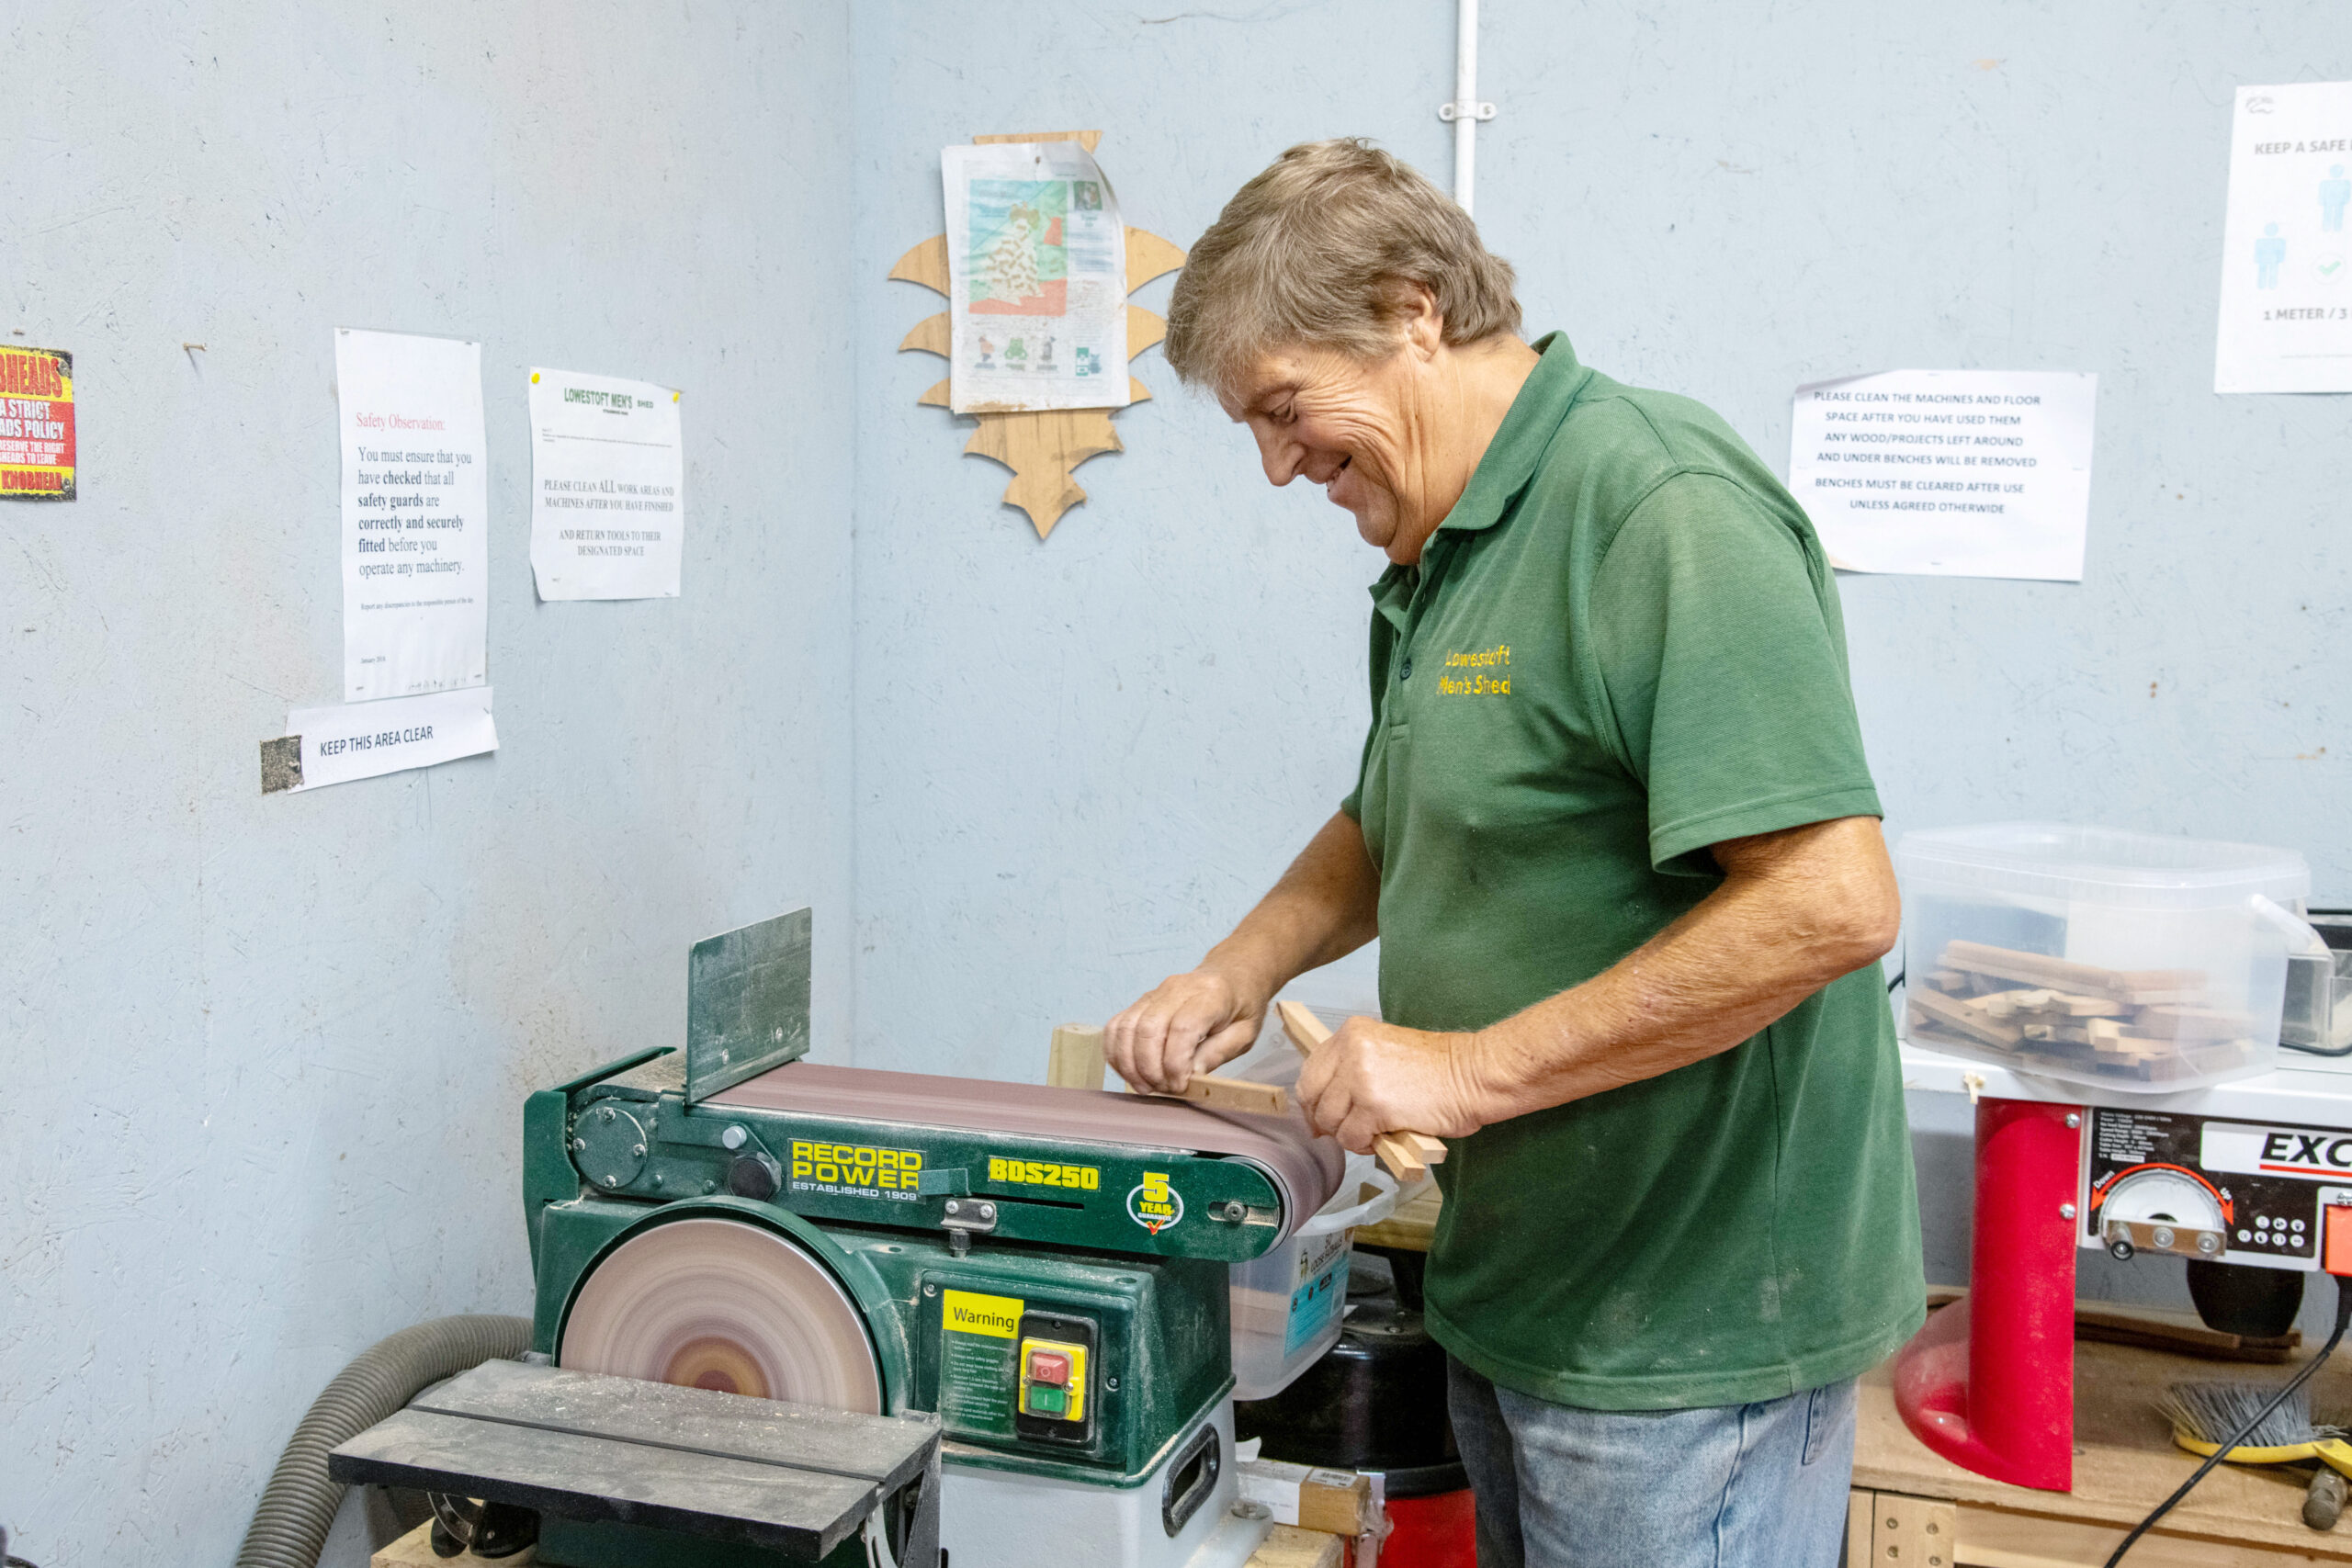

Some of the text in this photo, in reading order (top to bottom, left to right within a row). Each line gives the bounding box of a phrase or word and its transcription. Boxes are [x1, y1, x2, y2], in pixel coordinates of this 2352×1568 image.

[2255, 140, 2346, 154] KEEP A SAFE
[2264, 310, 2271, 321] 1
[2276, 309, 2324, 320] METER
[2339, 309, 2347, 320] 3
[564, 388, 654, 410] LOWESTOFT MEN'S SHED
[1814, 391, 2041, 406] PLEASE CLEAN THE MACHINES AND FLOOR
[8, 399, 51, 421] STRICT
[1826, 412, 2020, 425] SPACE AFTER YOU HAVE USED THEM
[25, 420, 64, 439] POLICY
[356, 412, 446, 432] Safety Observation:
[29, 441, 43, 452] THE
[44, 443, 64, 453] RIGHT
[1825, 433, 2024, 446] ANY WOOD/PROJECTS LEFT AROUND
[27, 453, 36, 464] TO
[37, 454, 56, 465] LEAVE
[357, 446, 472, 467] You must ensure that you
[1816, 452, 2037, 468] AND UNDER BENCHES WILL BE REMOVED
[2, 470, 62, 491] KNOBHEAD
[358, 469, 454, 485] have checked that all
[1815, 478, 2025, 493] BENCHES MUST BE CLEARED AFTER USE
[544, 479, 674, 497] PLEASE CLEAN ALL WORK AREAS AND
[357, 493, 440, 511] safety guards are
[545, 497, 673, 512] MACHINES AFTER YOU HAVE FINISHED
[1849, 500, 2006, 514] UNLESS AGREED OTHERWIDE
[358, 514, 464, 533] correctly and securely
[559, 530, 661, 541] AND RETURN TOOLS TO THEIR
[358, 537, 437, 554] fitted before you
[578, 546, 644, 557] DESIGNATED SPACE
[359, 558, 465, 579] operate any machinery.
[1445, 645, 1510, 667] Lowestoft
[1436, 674, 1510, 695] Men's Shed
[320, 725, 434, 757] KEEP THIS AREA CLEAR
[792, 1141, 922, 1171] RECORD
[2260, 1132, 2352, 1168] EXC
[792, 1161, 919, 1190] POWER
[989, 1157, 1099, 1190] BDS250
[2093, 1170, 2115, 1189] Down
[792, 1181, 917, 1201] ESTABLISHED 1909
[1143, 1171, 1169, 1202] 5
[1139, 1201, 1172, 1214] YEAR
[954, 1306, 1014, 1332] Warning
